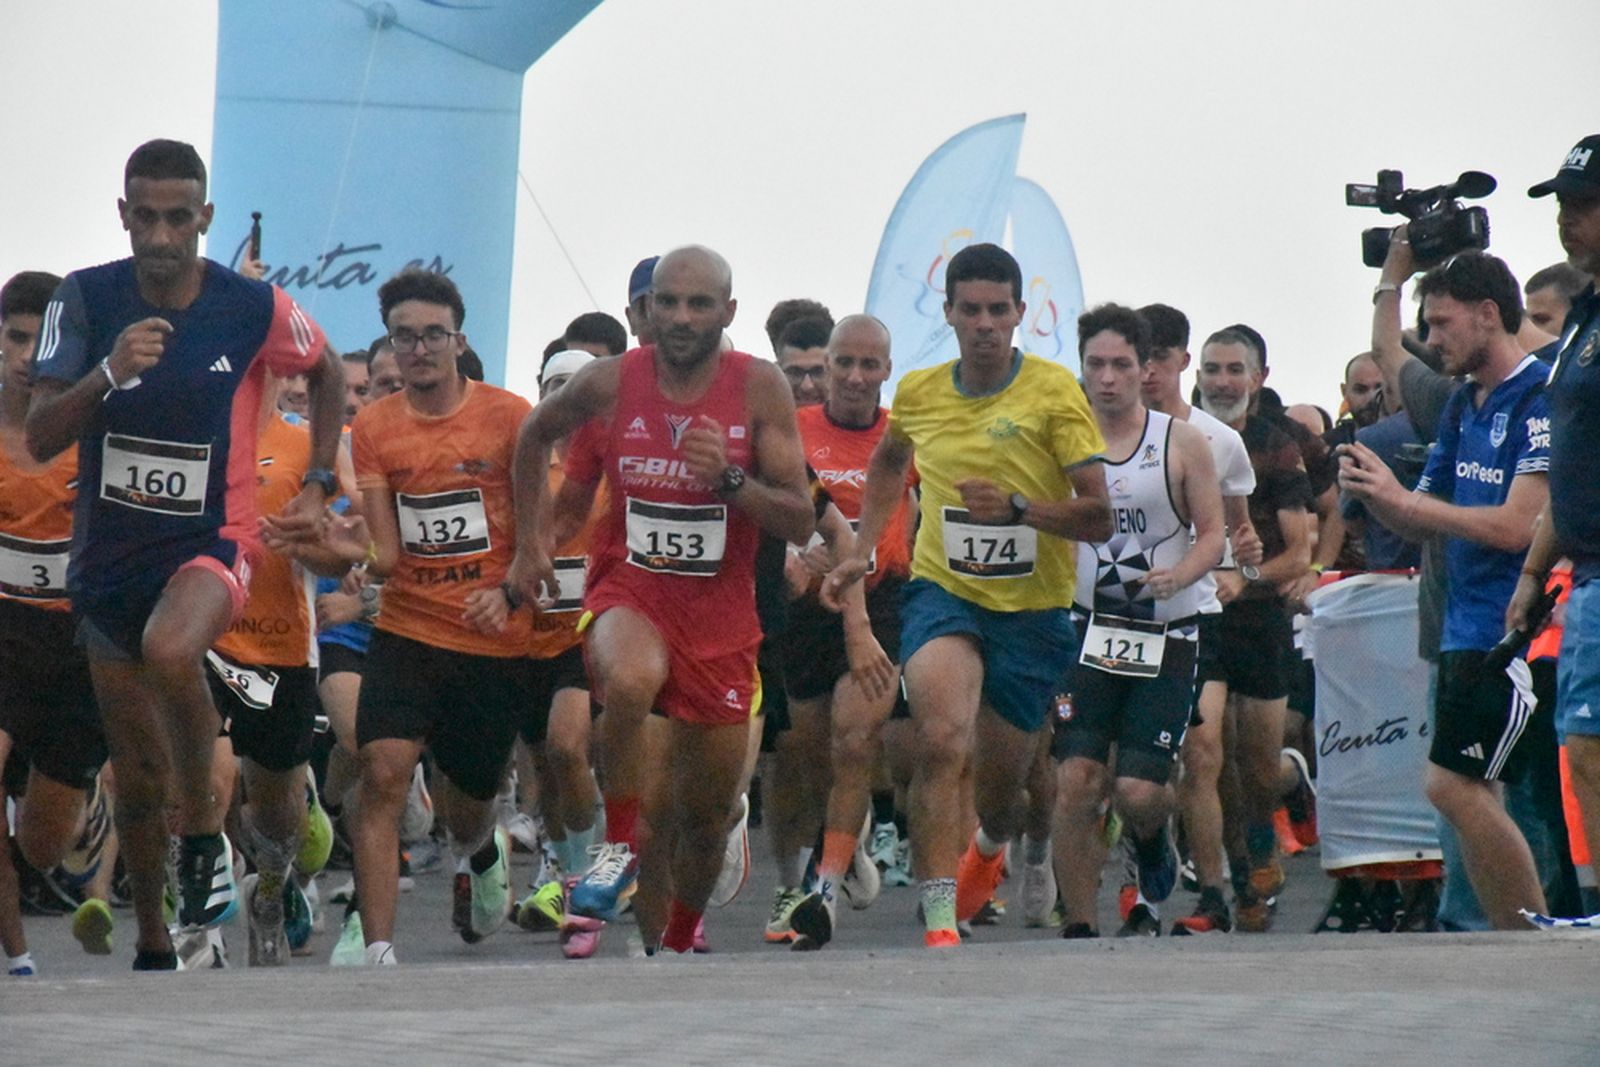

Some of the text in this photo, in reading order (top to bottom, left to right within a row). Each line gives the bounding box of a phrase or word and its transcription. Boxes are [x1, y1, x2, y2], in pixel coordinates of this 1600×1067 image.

[229, 233, 382, 291] uta
[125, 465, 187, 498] 160
[417, 516, 471, 543] 132
[646, 531, 705, 559] 153
[963, 537, 1018, 563] 174
[31, 564, 51, 587] 3
[1101, 637, 1147, 664] 121
